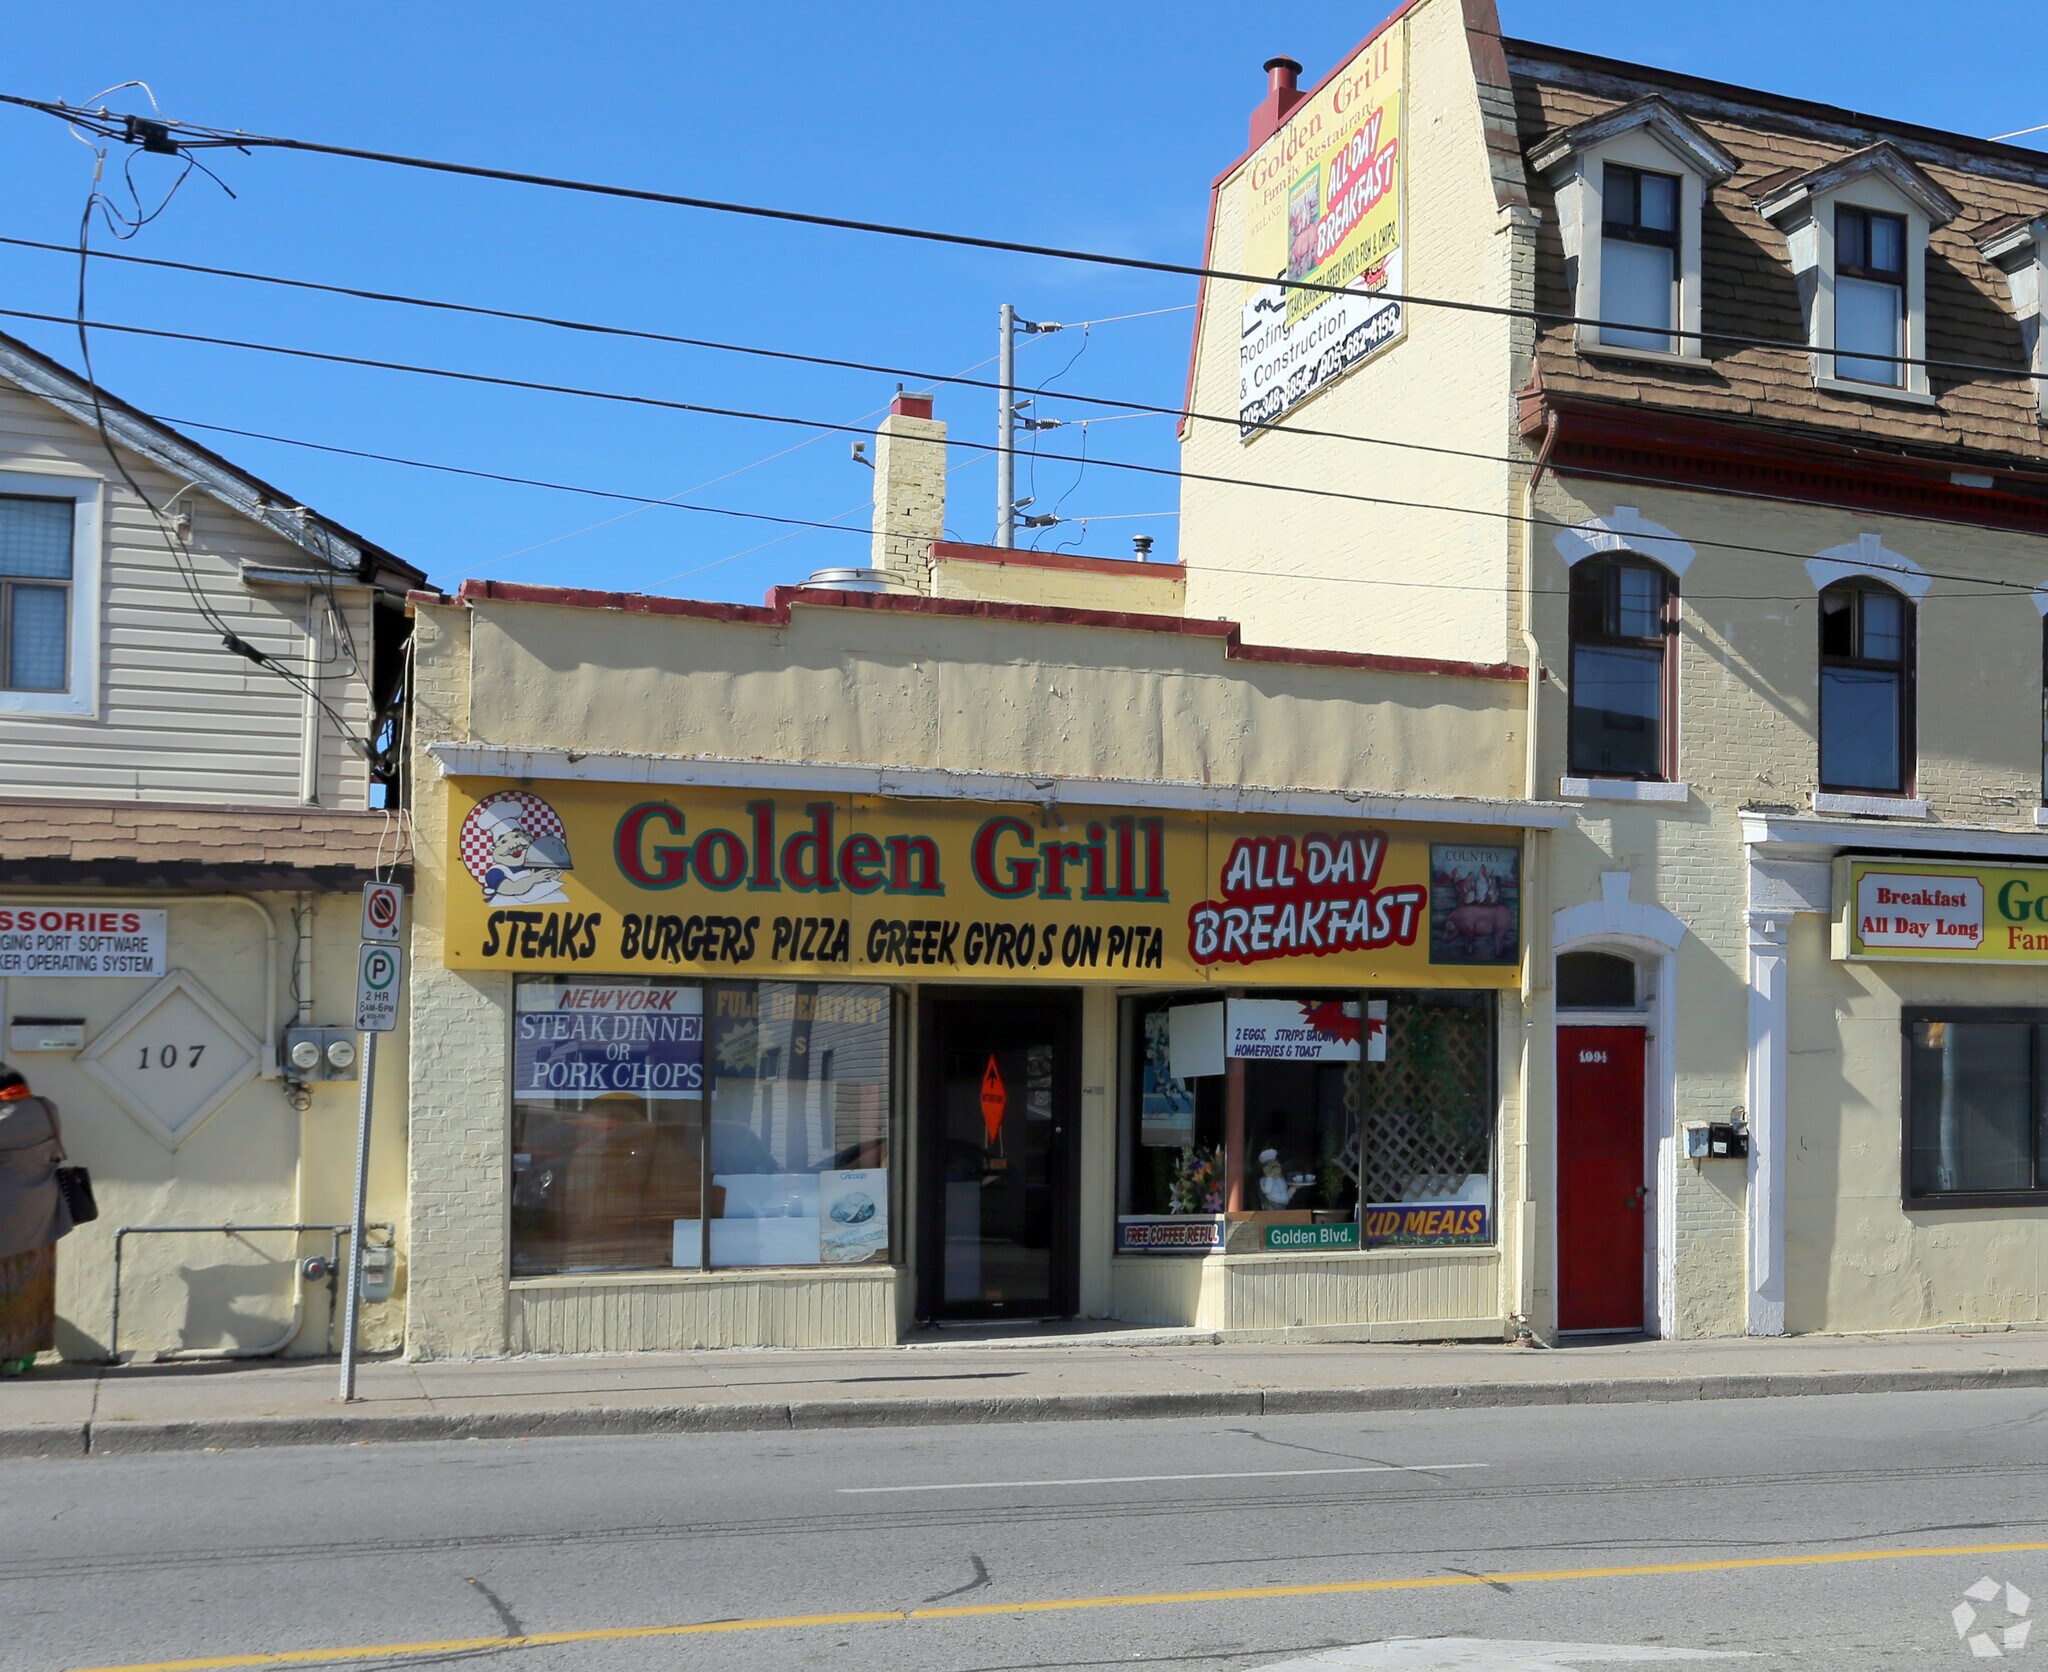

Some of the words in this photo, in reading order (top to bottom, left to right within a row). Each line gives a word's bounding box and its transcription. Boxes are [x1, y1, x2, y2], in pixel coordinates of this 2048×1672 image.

[1252, 113, 1323, 191] Golden
[1334, 39, 1389, 115] Grill
[1304, 97, 1375, 166] Restaurant
[1328, 149, 1349, 203] ALL
[1351, 112, 1381, 172] DAY
[1316, 144, 1395, 259] BREAKFAST
[1250, 205, 1281, 238] WELLAND
[1379, 221, 1396, 252] CHIPS
[1254, 309, 1347, 388] Construction
[613, 799, 946, 897] Golden
[971, 814, 1170, 903] Grill
[1226, 843, 1297, 892] ALL
[1305, 836, 1381, 885] DAY
[1445, 850, 1501, 863] COUNTRY
[1876, 887, 1967, 908] Breakfast
[1192, 890, 1420, 957] BREAKFAST
[1861, 916, 1889, 934] All
[1894, 917, 1930, 939] Day
[1936, 919, 1979, 941] Long
[37, 935, 71, 952] PORT
[78, 936, 149, 954] SOFTWARE
[482, 910, 602, 961] STEAKS
[620, 914, 760, 964] BURGERS
[771, 916, 849, 963] PIZZA
[867, 919, 960, 968] GREEK
[1061, 924, 1102, 969] ON
[1106, 925, 1163, 969] PITA
[26, 954, 98, 972] OPERATING
[102, 956, 153, 973] SYSTEM
[372, 958, 387, 980] P
[365, 991, 372, 1001] 2
[374, 991, 389, 1002] HR
[558, 988, 615, 1011] NEW
[615, 989, 678, 1012] YORK
[715, 990, 763, 1019] FULL
[771, 991, 882, 1025] BREAKFAST
[520, 1014, 608, 1042] STEAK
[1235, 1027, 1242, 1041] 2
[1242, 1028, 1267, 1042] EGGS,
[1274, 1029, 1306, 1042] STRIPS
[136, 1043, 206, 1071] 107
[606, 1042, 631, 1061] OR
[1234, 1043, 1285, 1058] HOMEFRIES
[1294, 1045, 1322, 1058] TOAST
[529, 1061, 609, 1089] PORK
[612, 1062, 704, 1090] CHOPS
[1125, 1225, 1150, 1244] FREE
[1150, 1225, 1187, 1245] COFFEE
[1186, 1224, 1219, 1245] REFILL
[1270, 1228, 1317, 1246] Golden
[1319, 1227, 1353, 1244] Blvd.
[1366, 1210, 1401, 1237] KID
[1402, 1209, 1484, 1237] MEALS
